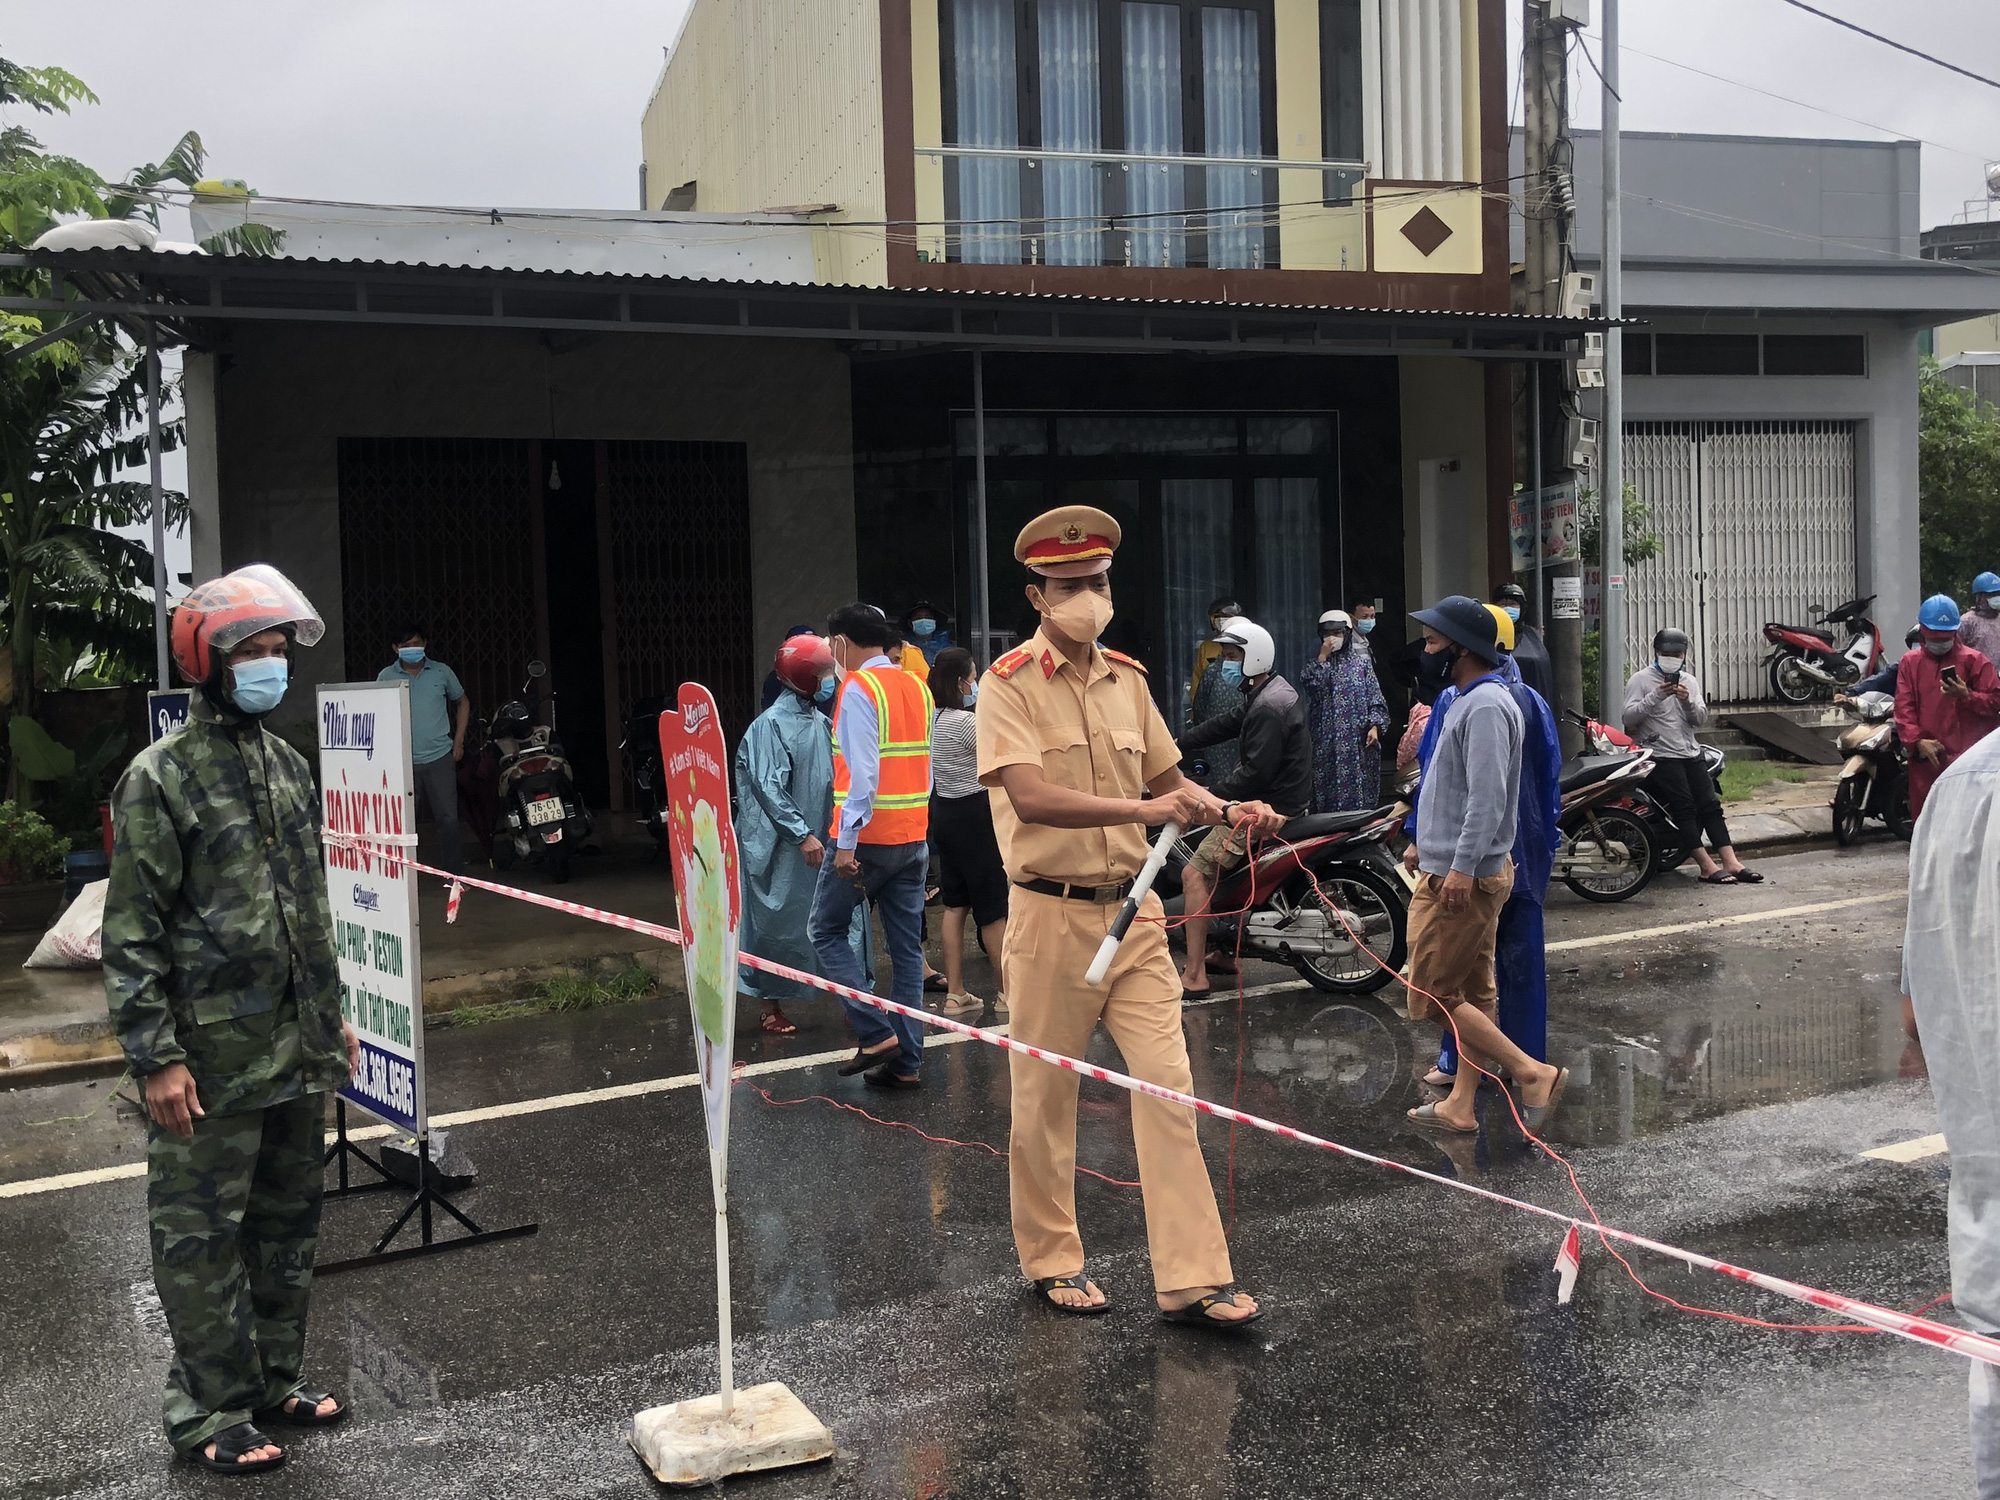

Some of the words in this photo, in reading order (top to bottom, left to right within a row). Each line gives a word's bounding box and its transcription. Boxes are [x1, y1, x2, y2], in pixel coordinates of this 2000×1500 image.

[323, 700, 348, 748] Nhà
[351, 712, 375, 761] may
[682, 699, 710, 726] Merino
[706, 752, 720, 780] Nam
[326, 768, 372, 874] HOÀNG
[372, 769, 404, 880] VÂN
[372, 929, 403, 978] VESTON
[385, 998, 411, 1049] TRANG
